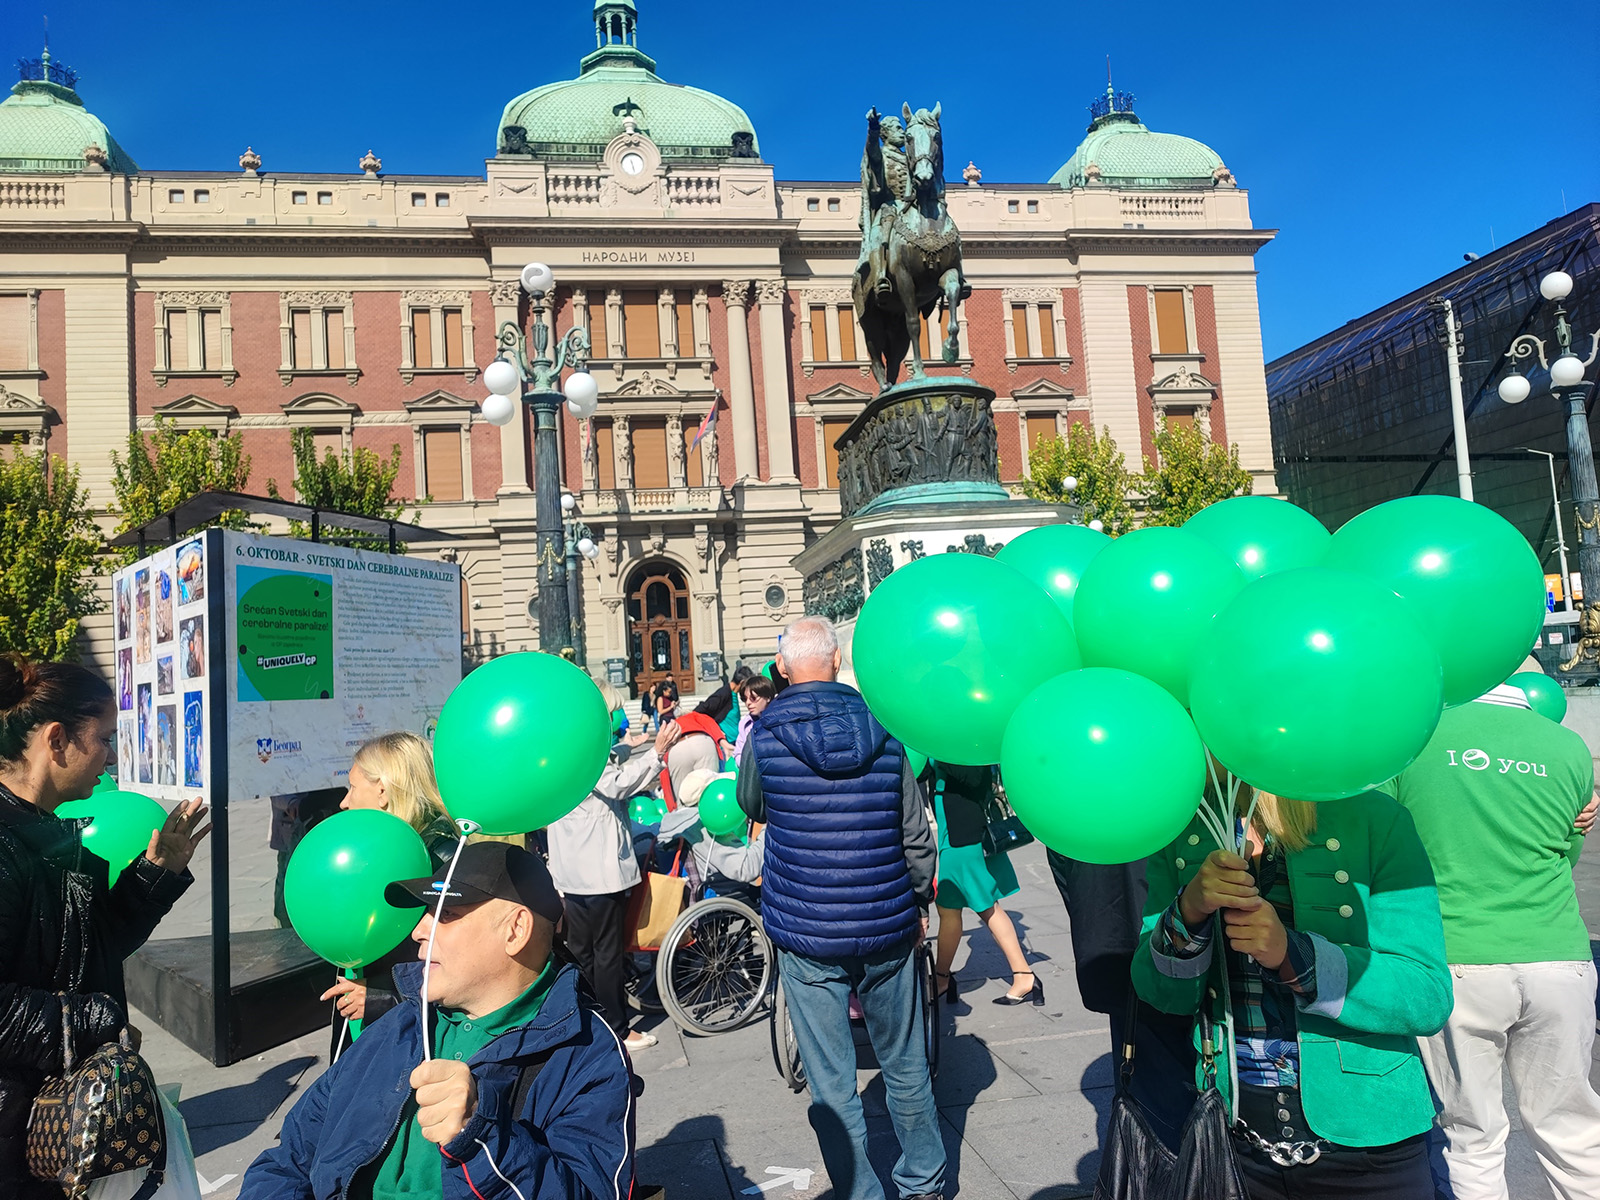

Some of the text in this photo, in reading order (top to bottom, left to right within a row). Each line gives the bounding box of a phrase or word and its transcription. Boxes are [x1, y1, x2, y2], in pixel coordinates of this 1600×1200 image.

[582, 251, 695, 262] НАРОДНИ МУЗЕЈ
[235, 545, 246, 557] 6.
[247, 546, 299, 564] OKTOBAR
[306, 554, 345, 570] SVETSKI
[347, 560, 367, 571] DAN
[367, 562, 419, 578] CEREBRALNE
[419, 569, 455, 582] PARALIZE
[243, 603, 276, 616] Srećan
[278, 605, 311, 618] Svetski
[312, 608, 328, 618] dan
[242, 617, 293, 630] cerebralne
[294, 620, 329, 632] paralize!
[1446, 750, 1548, 777] I you
